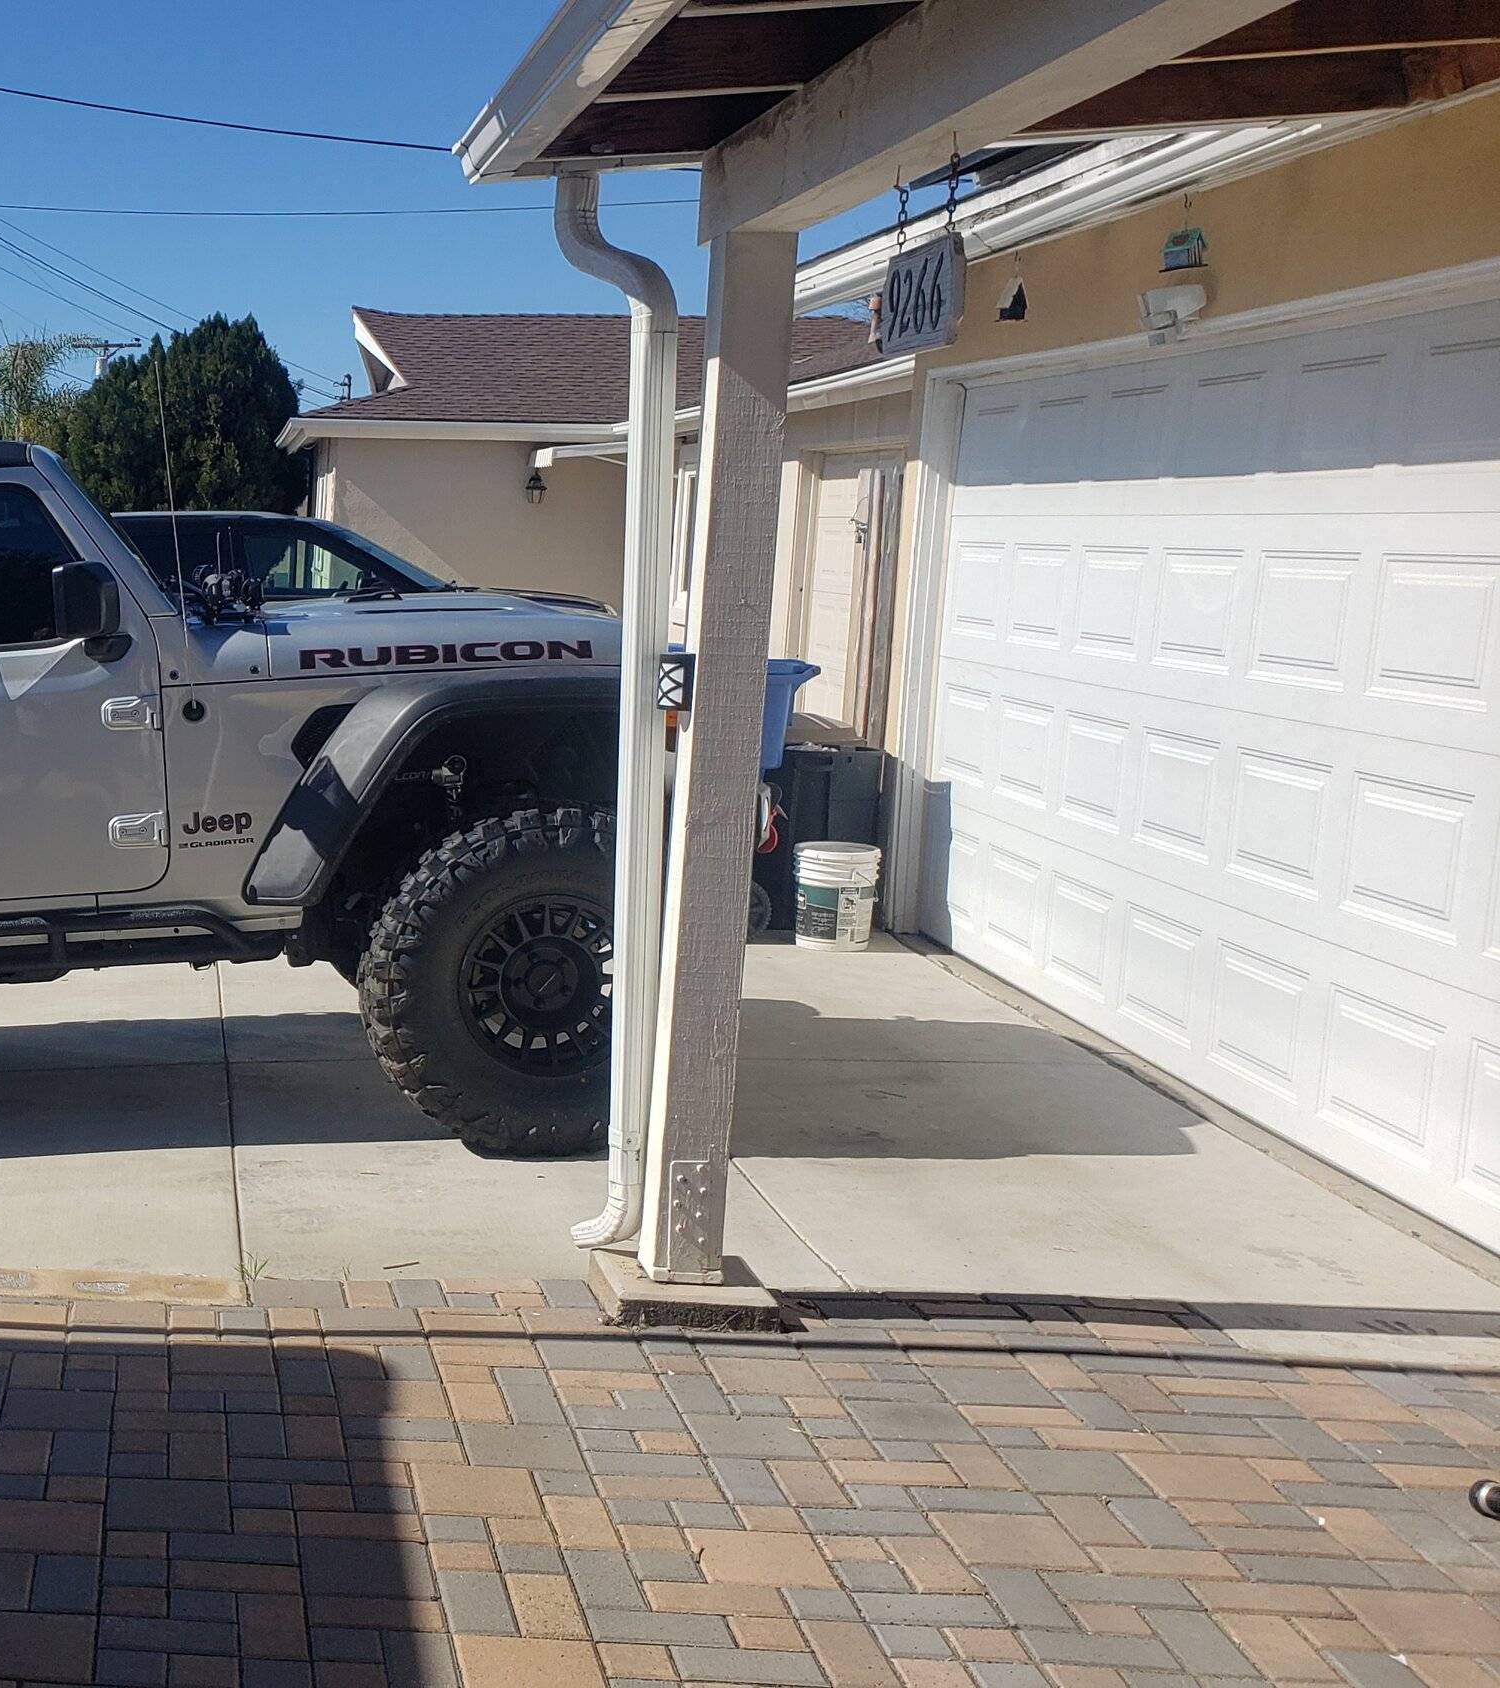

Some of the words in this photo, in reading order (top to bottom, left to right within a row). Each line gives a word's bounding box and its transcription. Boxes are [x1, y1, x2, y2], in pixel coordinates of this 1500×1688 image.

[887, 251, 944, 342] 9266
[299, 640, 594, 671] RUBICON
[182, 811, 252, 834] Jeep
[189, 837, 255, 848] GLADIATOR
